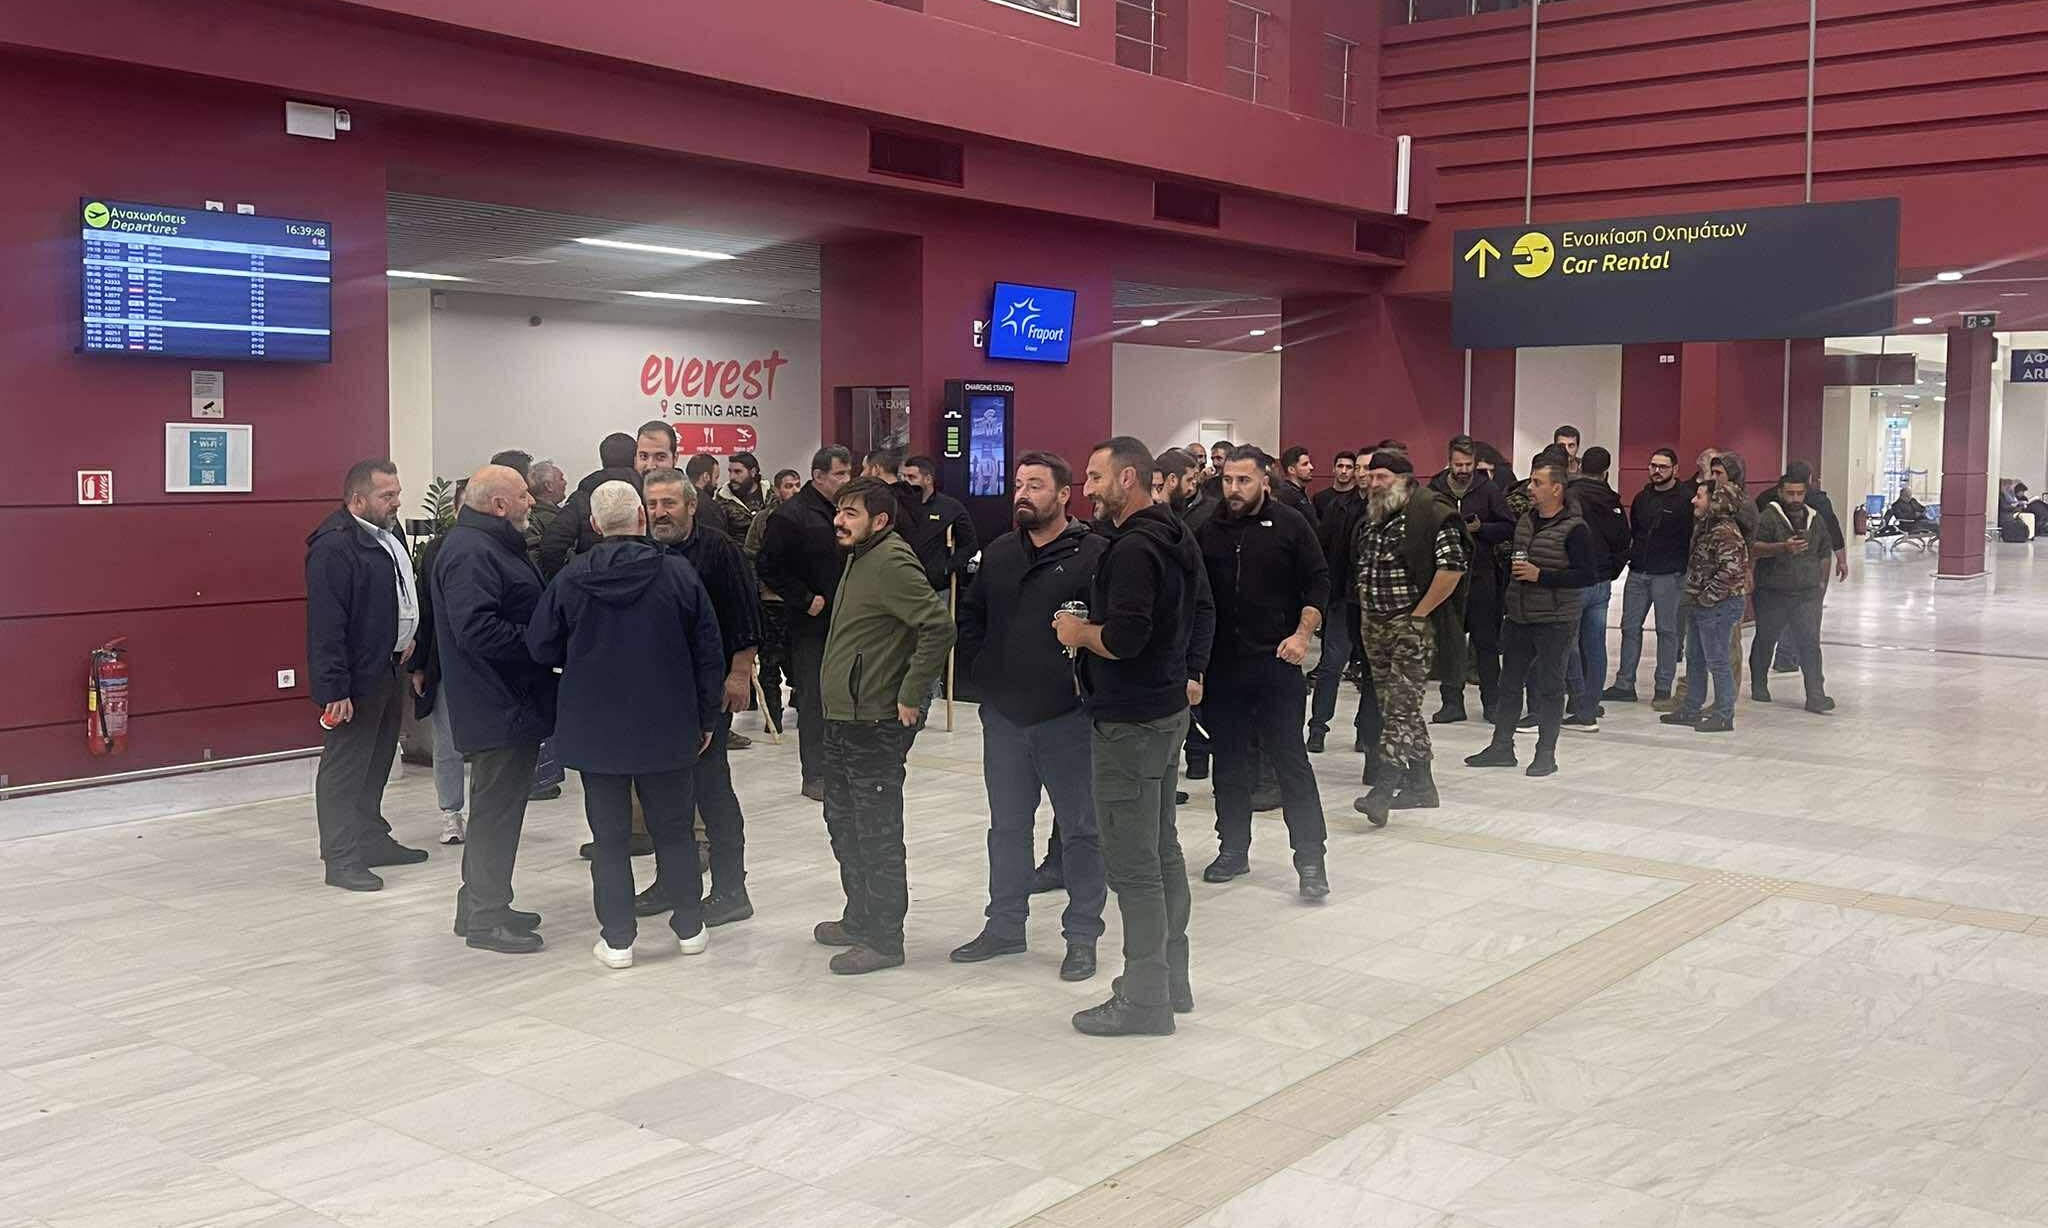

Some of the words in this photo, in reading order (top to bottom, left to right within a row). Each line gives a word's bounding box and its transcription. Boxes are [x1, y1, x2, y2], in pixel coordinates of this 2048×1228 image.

[110, 207, 187, 225] Αναχωρήσεις
[111, 219, 178, 235] Departures
[286, 224, 326, 238] 16:39:48
[1562, 228, 1647, 248] Ενοικίαση
[1652, 221, 1747, 243] Οχημάτων
[1562, 256, 1598, 274] Car
[1602, 251, 1670, 272] Rental
[1027, 324, 1065, 345] Fraport
[640, 350, 789, 401] everest
[964, 383, 992, 391] CHARGING
[992, 384, 1014, 392] STATION
[674, 403, 723, 417] SITTING
[725, 405, 759, 417] AREA
